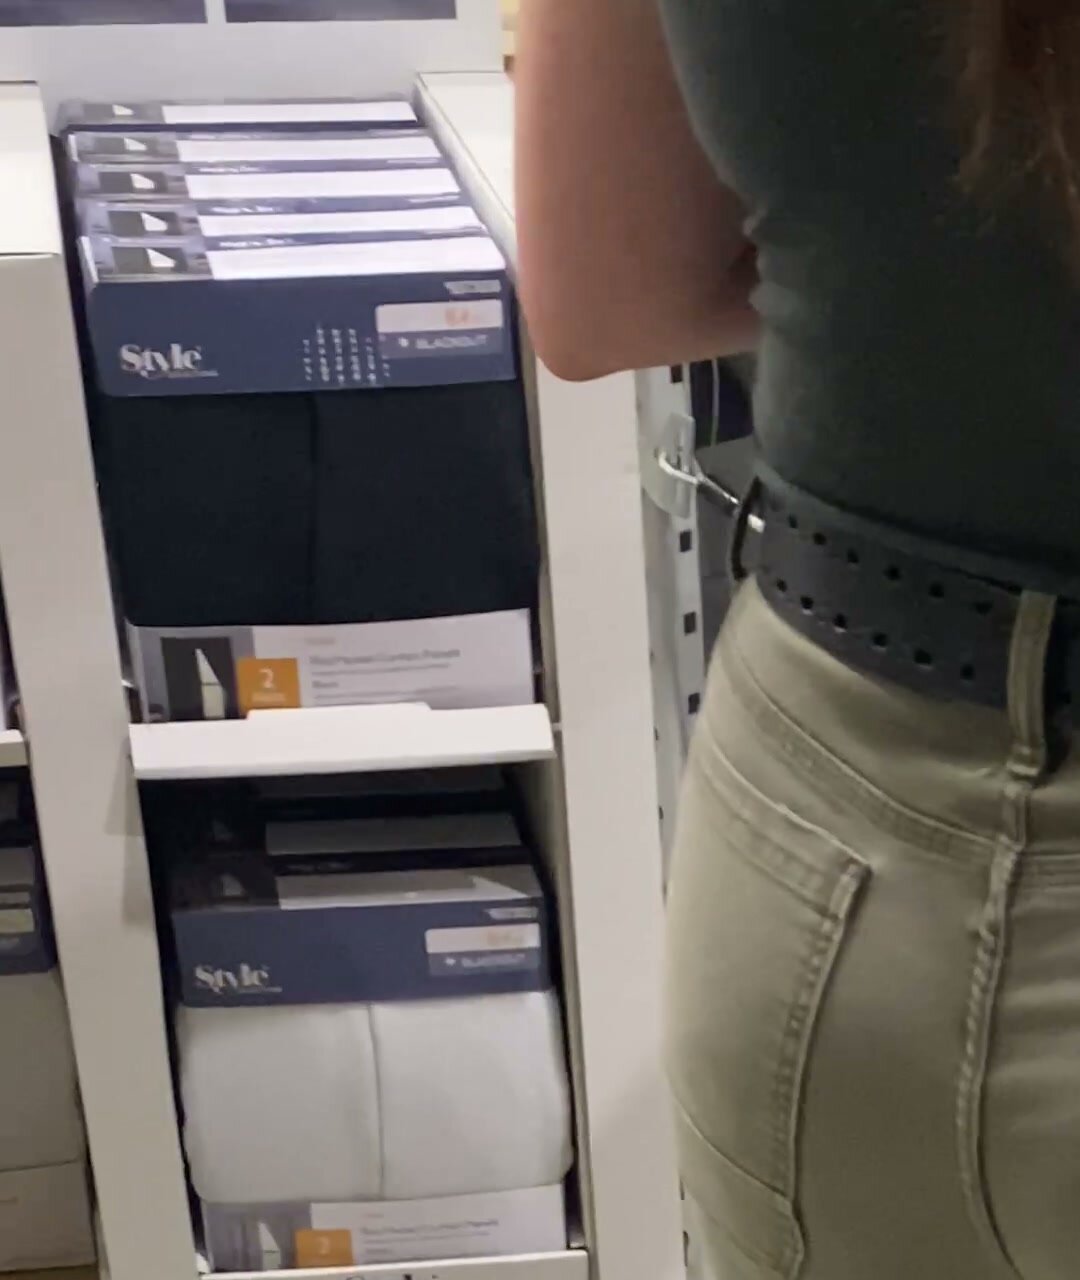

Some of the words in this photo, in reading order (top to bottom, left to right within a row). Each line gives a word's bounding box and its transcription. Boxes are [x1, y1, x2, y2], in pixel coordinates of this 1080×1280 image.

[119, 342, 204, 378] Style
[259, 668, 275, 688] 2
[195, 963, 269, 994] Style
